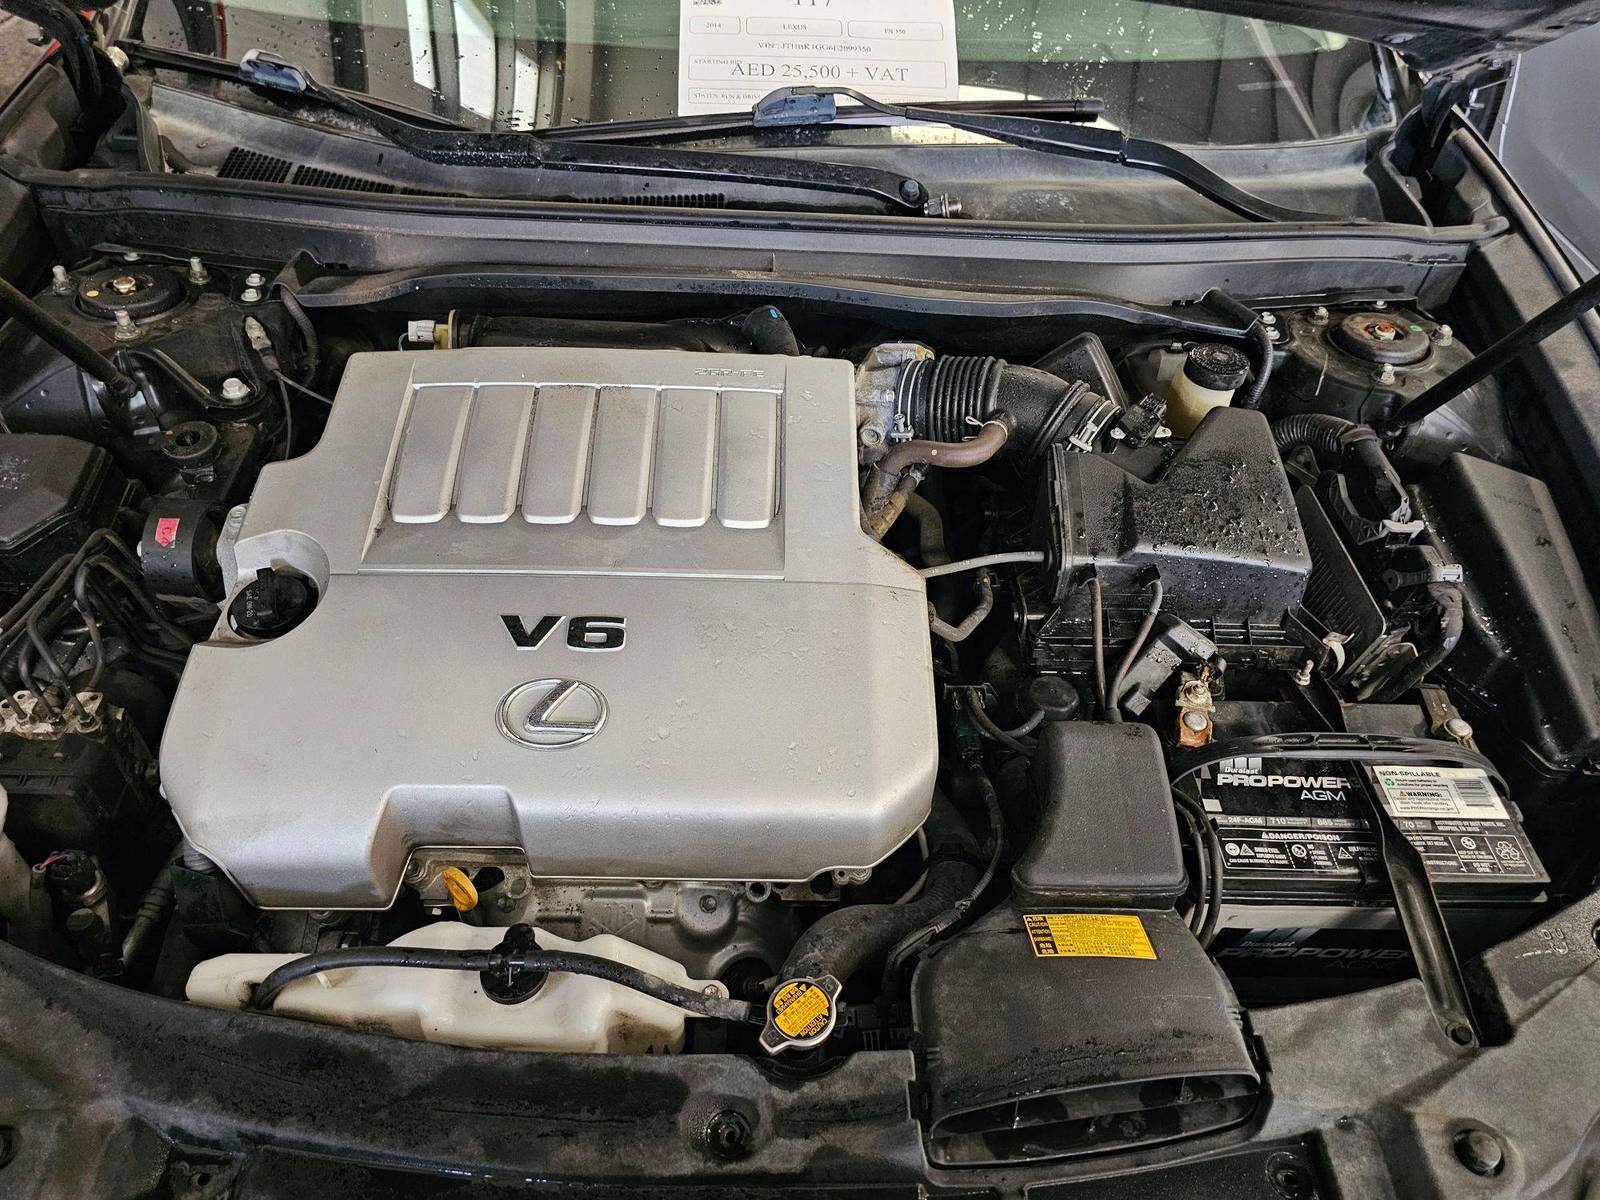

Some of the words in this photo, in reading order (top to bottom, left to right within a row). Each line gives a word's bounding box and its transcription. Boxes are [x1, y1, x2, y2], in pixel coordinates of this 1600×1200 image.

[782, 23, 808, 31] LEXUS
[731, 63, 775, 77] AED
[782, 64, 841, 80] 25,500
[846, 68, 859, 79] +
[864, 67, 909, 82] VAT
[500, 615, 627, 652] V6
[1224, 766, 1259, 775] Duralast
[1379, 770, 1441, 778] NON-SPILLABLE
[1300, 789, 1347, 801] AGM
[1270, 817, 1286, 826] 710
[1402, 820, 1415, 829] 70
[1268, 832, 1341, 842] DANGER/POISON
[1217, 947, 1411, 959] PROPOWE
